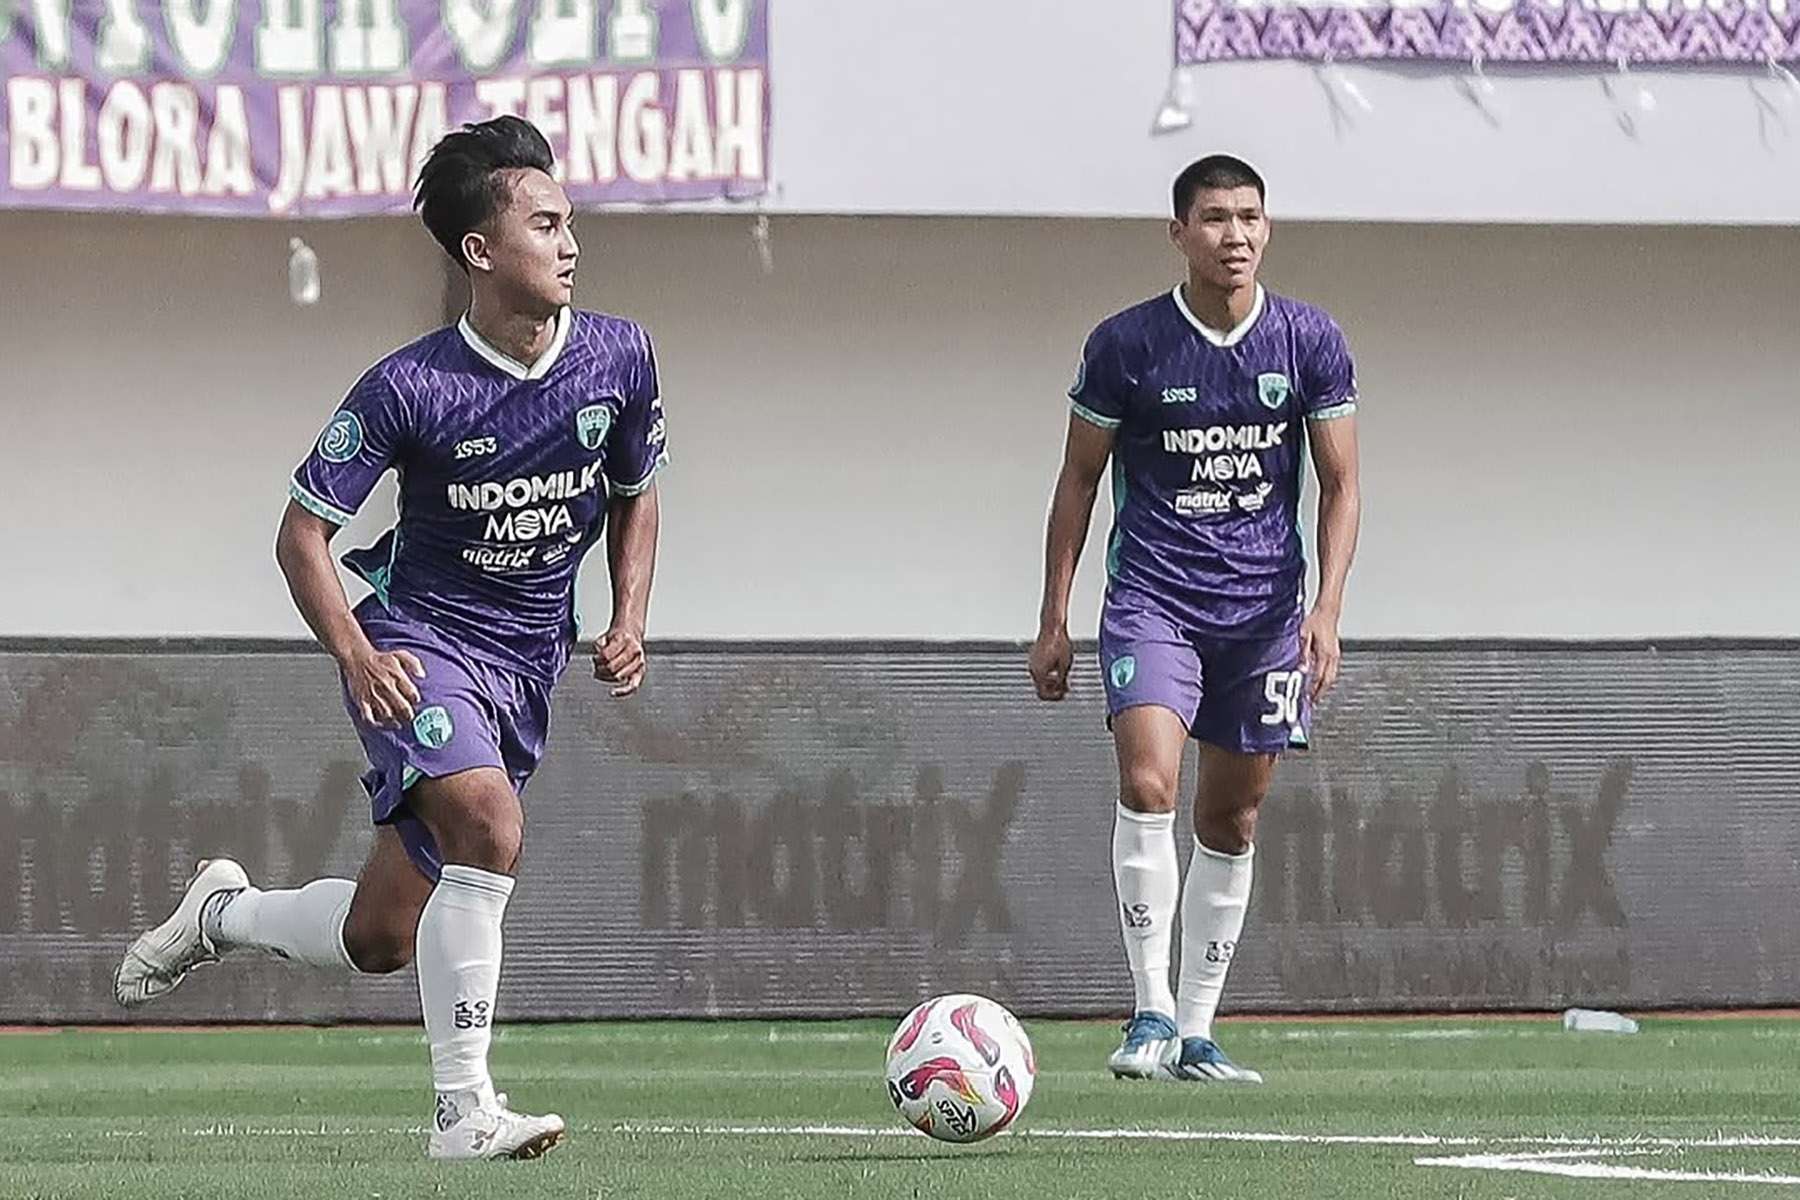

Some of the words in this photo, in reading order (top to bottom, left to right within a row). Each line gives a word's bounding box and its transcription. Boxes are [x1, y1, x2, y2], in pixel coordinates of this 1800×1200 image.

[6, 75, 256, 196] BLORA
[267, 83, 449, 212] JAWA
[475, 68, 764, 184] TENGAH
[453, 436, 497, 459] 1953
[1162, 421, 1288, 453] INDOMILK
[448, 457, 602, 511] INDOMILK
[1191, 453, 1263, 481] MOYA
[483, 504, 573, 542] MOYA
[1261, 670, 1303, 725] 50
